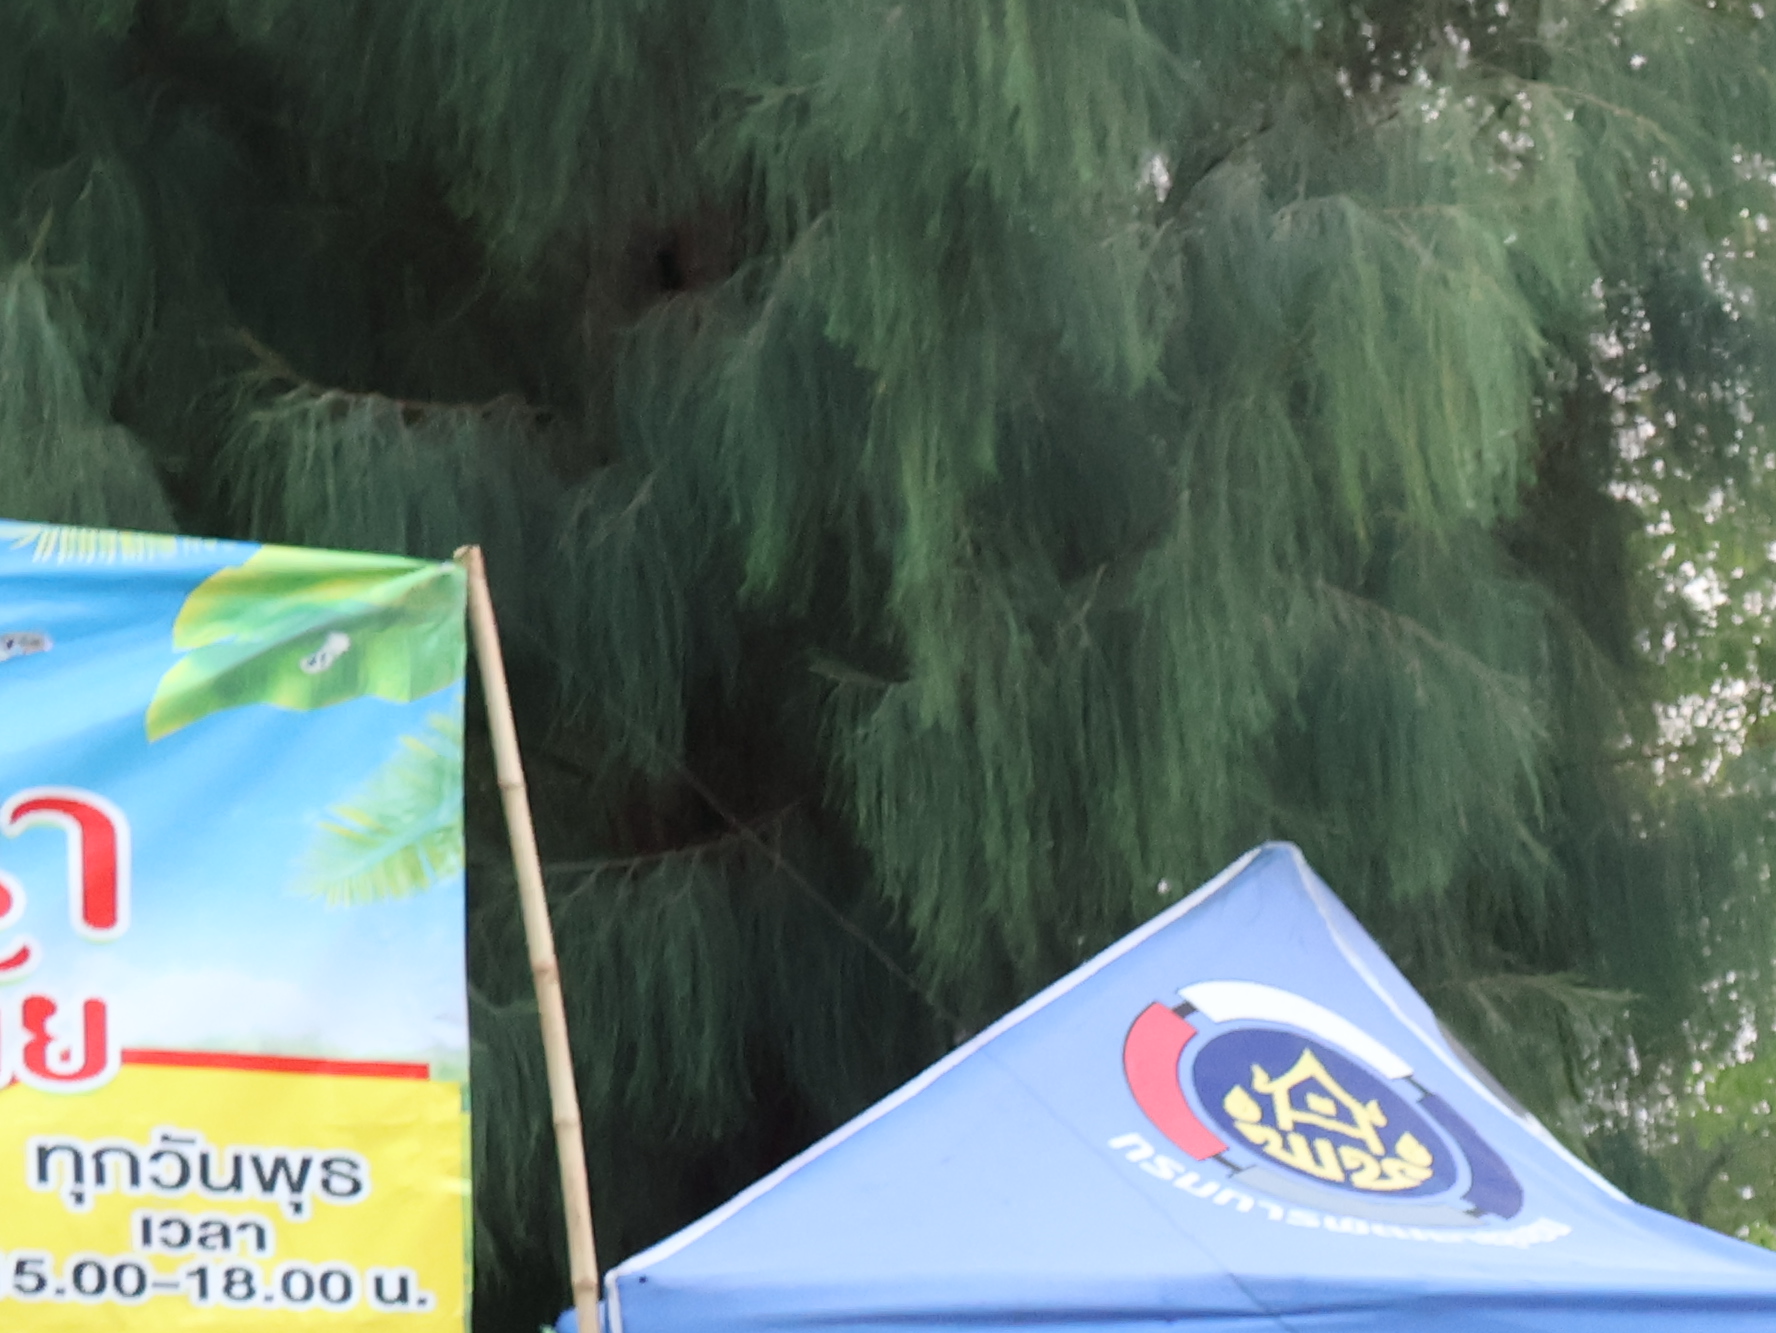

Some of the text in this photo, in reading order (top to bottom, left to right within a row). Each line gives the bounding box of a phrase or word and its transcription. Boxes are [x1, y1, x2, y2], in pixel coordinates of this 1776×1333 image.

[36, 1133, 363, 1215] ทุกวันพุธ
[141, 1215, 268, 1252] เวลา
[374, 1273, 429, 1306] น.
